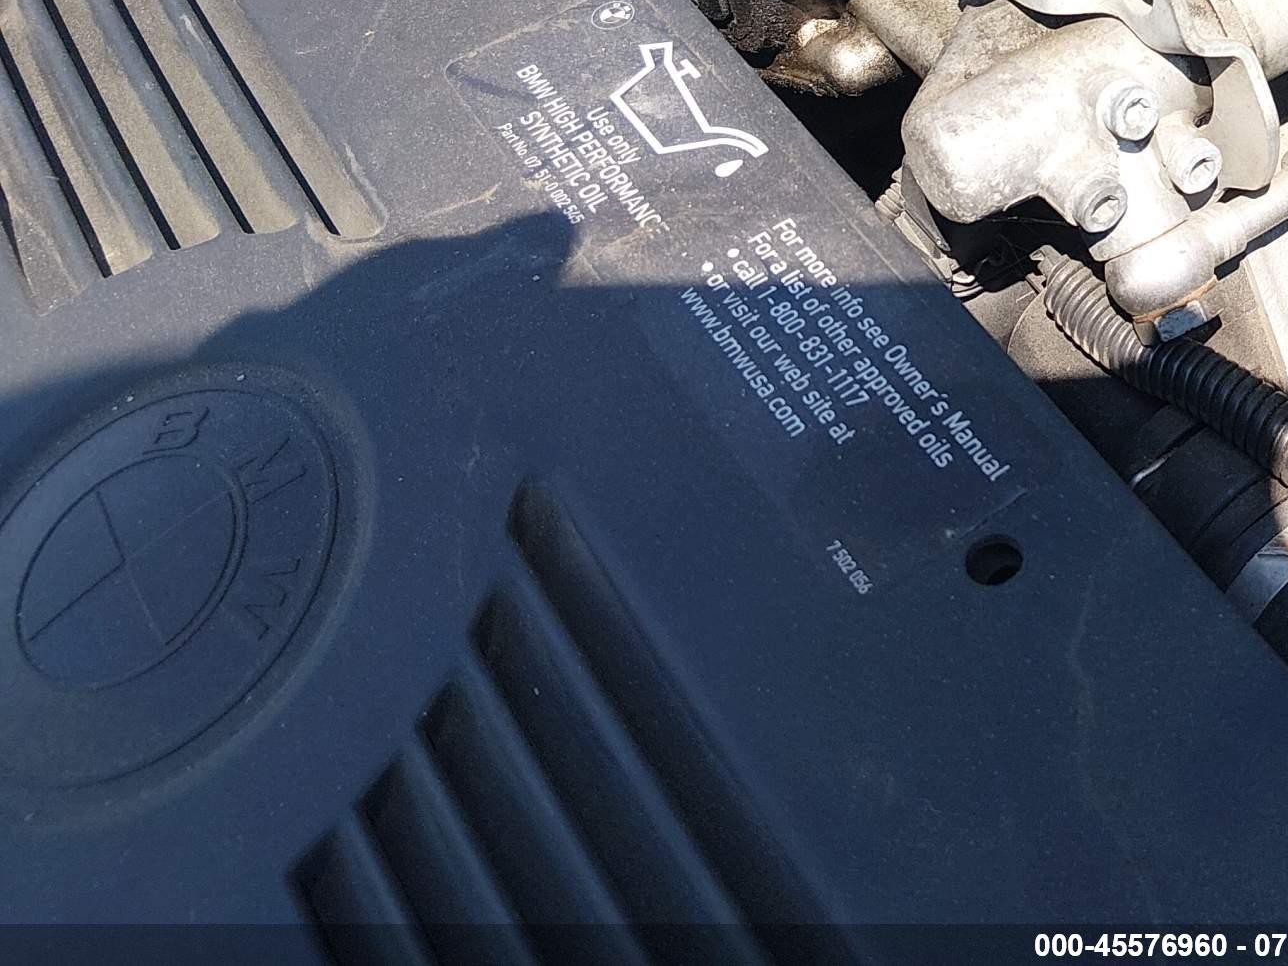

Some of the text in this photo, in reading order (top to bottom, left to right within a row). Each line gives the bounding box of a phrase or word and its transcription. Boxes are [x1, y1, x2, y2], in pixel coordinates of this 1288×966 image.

[516, 64, 557, 100] BMW
[543, 97, 584, 135] HIGH
[587, 106, 641, 165] Use only
[497, 122, 519, 144] Part
[511, 141, 528, 159] No.
[549, 188, 571, 209] 002
[563, 204, 585, 225] 545
[520, 111, 609, 214] SYNTHETIC OIL
[680, 286, 806, 438] www.bmwusa.com
[706, 273, 856, 445] or visit our web site at
[732, 259, 871, 407] call 1-800-831-1117
[747, 231, 953, 468] For a list of other approved oils
[772, 217, 804, 246] For
[795, 246, 837, 288] more
[830, 283, 863, 319] info
[857, 317, 890, 349] see
[942, 411, 1011, 482] Manual
[826, 539, 873, 595] 7 502 056
